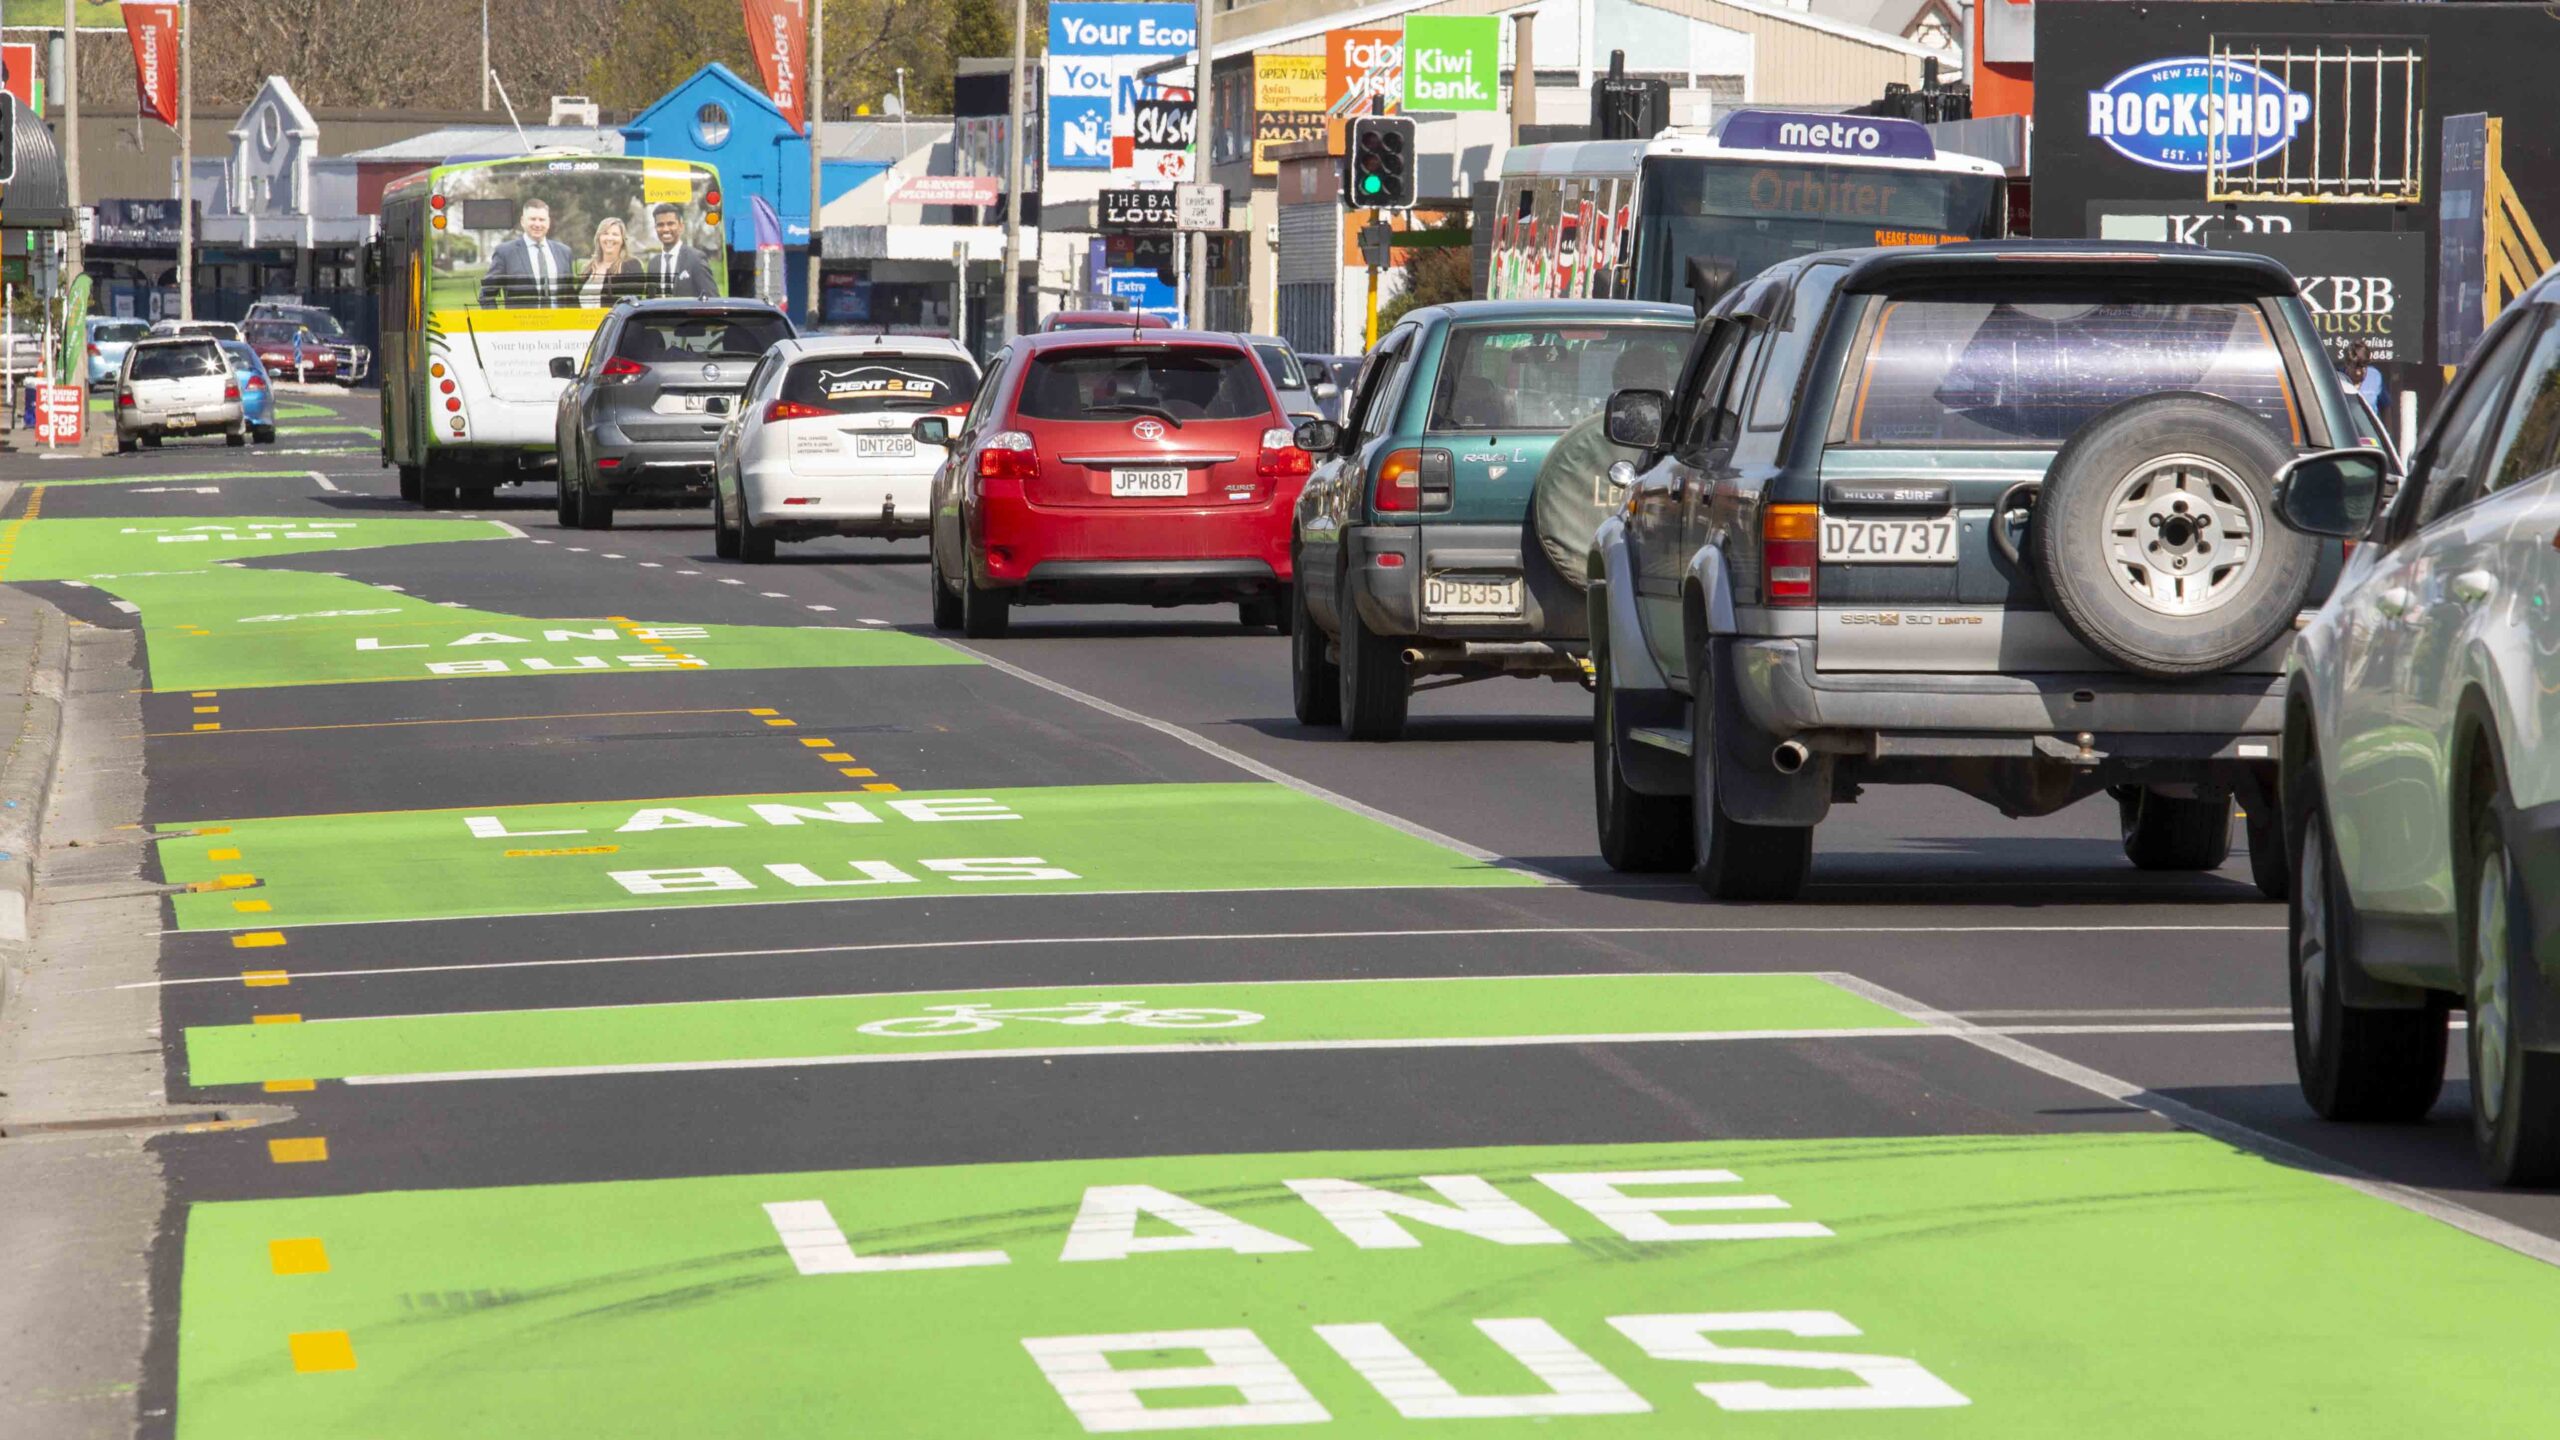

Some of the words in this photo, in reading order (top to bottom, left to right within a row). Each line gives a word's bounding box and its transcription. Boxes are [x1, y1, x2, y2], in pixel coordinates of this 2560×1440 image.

[1062, 17, 1132, 46] Your
[1415, 48, 1472, 74] Kiwi
[1259, 68, 1288, 80] OPEN
[1291, 69, 1298, 80] 7
[1415, 72, 1488, 100] bank.
[2152, 69, 2181, 83] NEW
[2186, 67, 2242, 82] ZEAAND
[1260, 111, 1327, 124] Asian
[2090, 92, 2309, 137] ROCKSHOP
[1260, 127, 1326, 140] MART
[1780, 122, 1879, 150] metro
[2161, 148, 2190, 161] EST.
[2197, 149, 2232, 162] 186
[1107, 194, 1140, 207] THE
[1750, 168, 1897, 216] Orbiter
[2297, 276, 2394, 314] KBB
[887, 378, 904, 391] 2
[39, 424, 78, 437] SOP
[1116, 472, 1183, 491] JPW887
[1845, 491, 1885, 500] HILUX
[1894, 490, 1934, 501] SURF
[1826, 523, 1951, 554] DZG737
[1429, 582, 1515, 606] DPB351
[1938, 617, 1983, 625] LIMITED
[356, 626, 711, 651] LANE
[425, 654, 709, 675] BUS
[464, 798, 1024, 839] LANE
[607, 857, 1083, 895] BUS
[763, 1169, 1836, 1276] LANE
[1021, 1310, 1972, 1434] BUS
